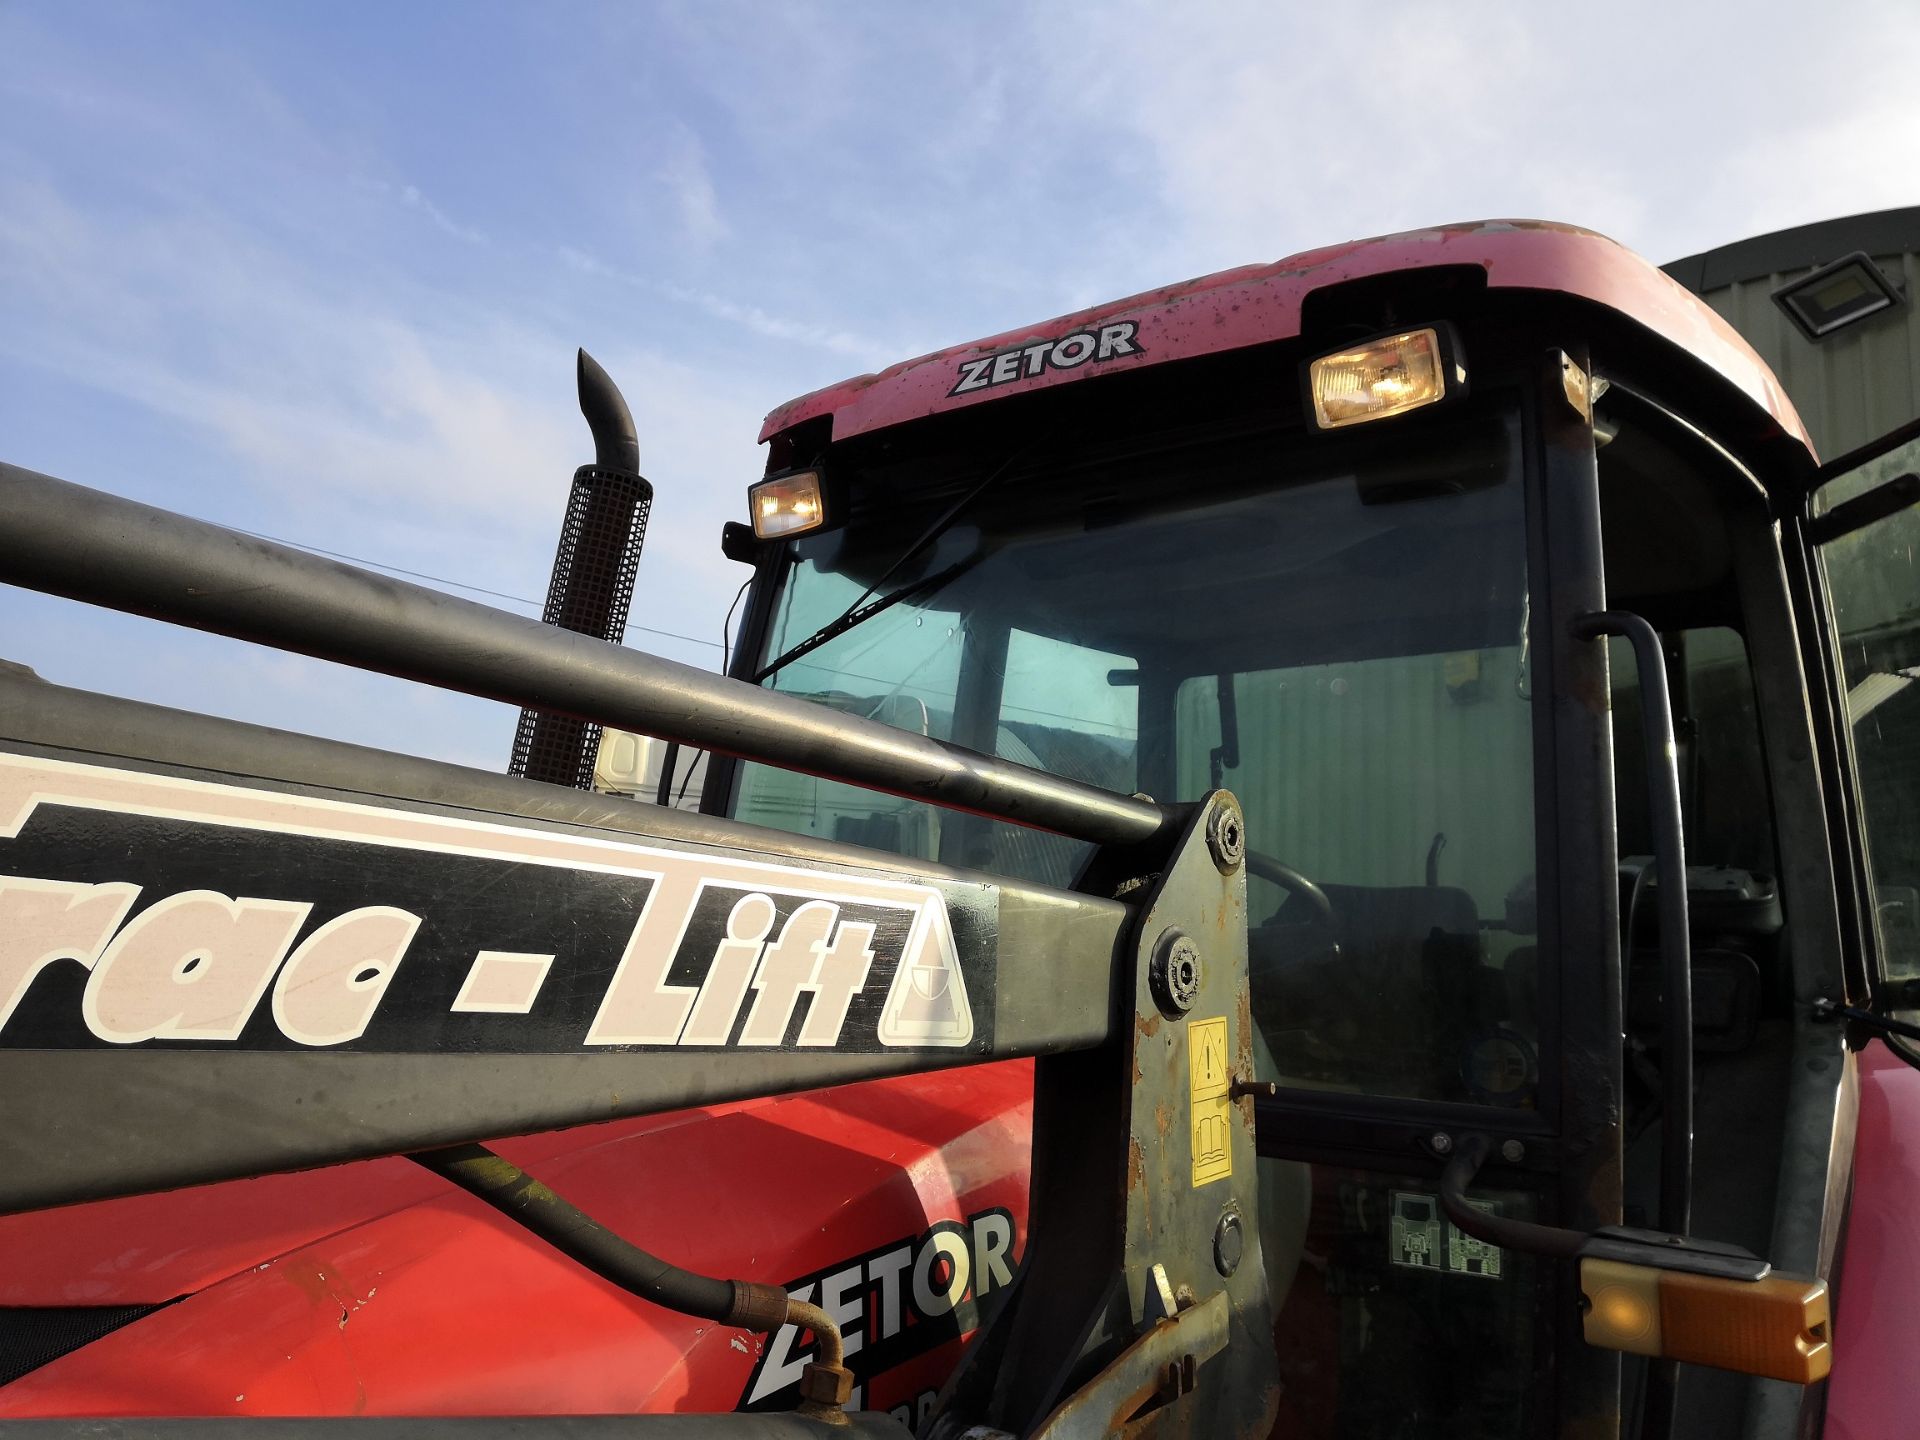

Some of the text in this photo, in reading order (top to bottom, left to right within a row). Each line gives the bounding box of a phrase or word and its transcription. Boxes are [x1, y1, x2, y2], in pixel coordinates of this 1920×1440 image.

[950, 321, 1139, 395] ZETOR
[0, 830, 423, 1047] rac
[583, 870, 877, 1047] Lift
[746, 1211, 1014, 1406] ZETOR
